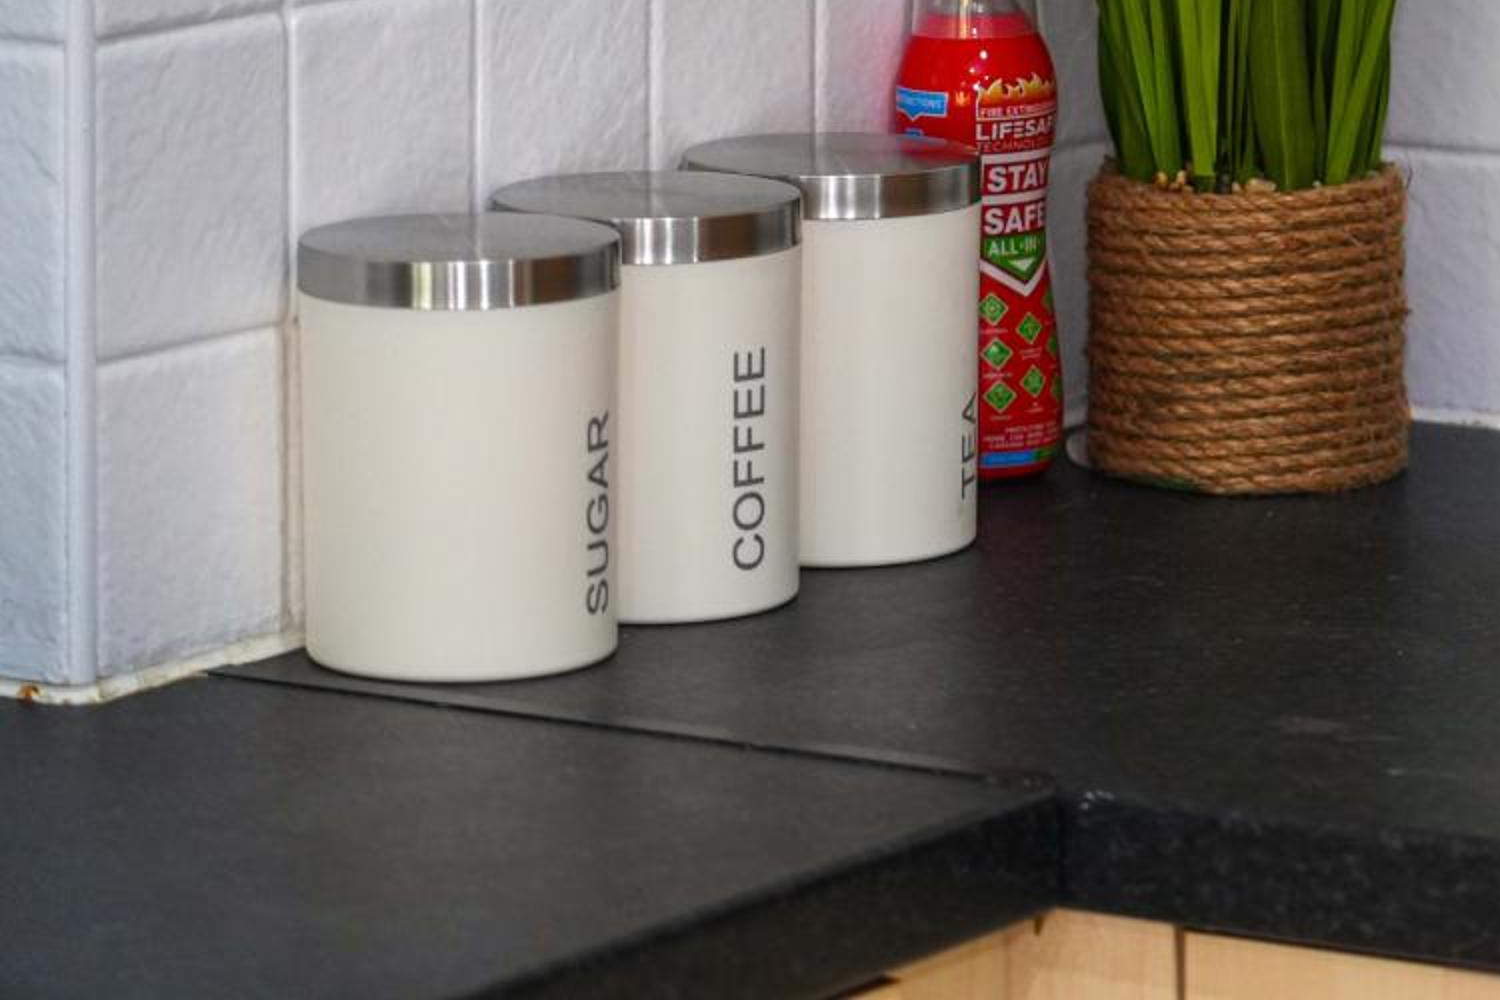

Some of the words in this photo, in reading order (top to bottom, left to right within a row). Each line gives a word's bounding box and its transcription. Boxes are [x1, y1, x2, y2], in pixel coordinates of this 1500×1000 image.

[983, 201, 1046, 235] SAFE
[986, 159, 1047, 193] STAY
[732, 345, 766, 571] COFFEE
[961, 390, 977, 500] TEA
[585, 409, 609, 615] SUGAR
